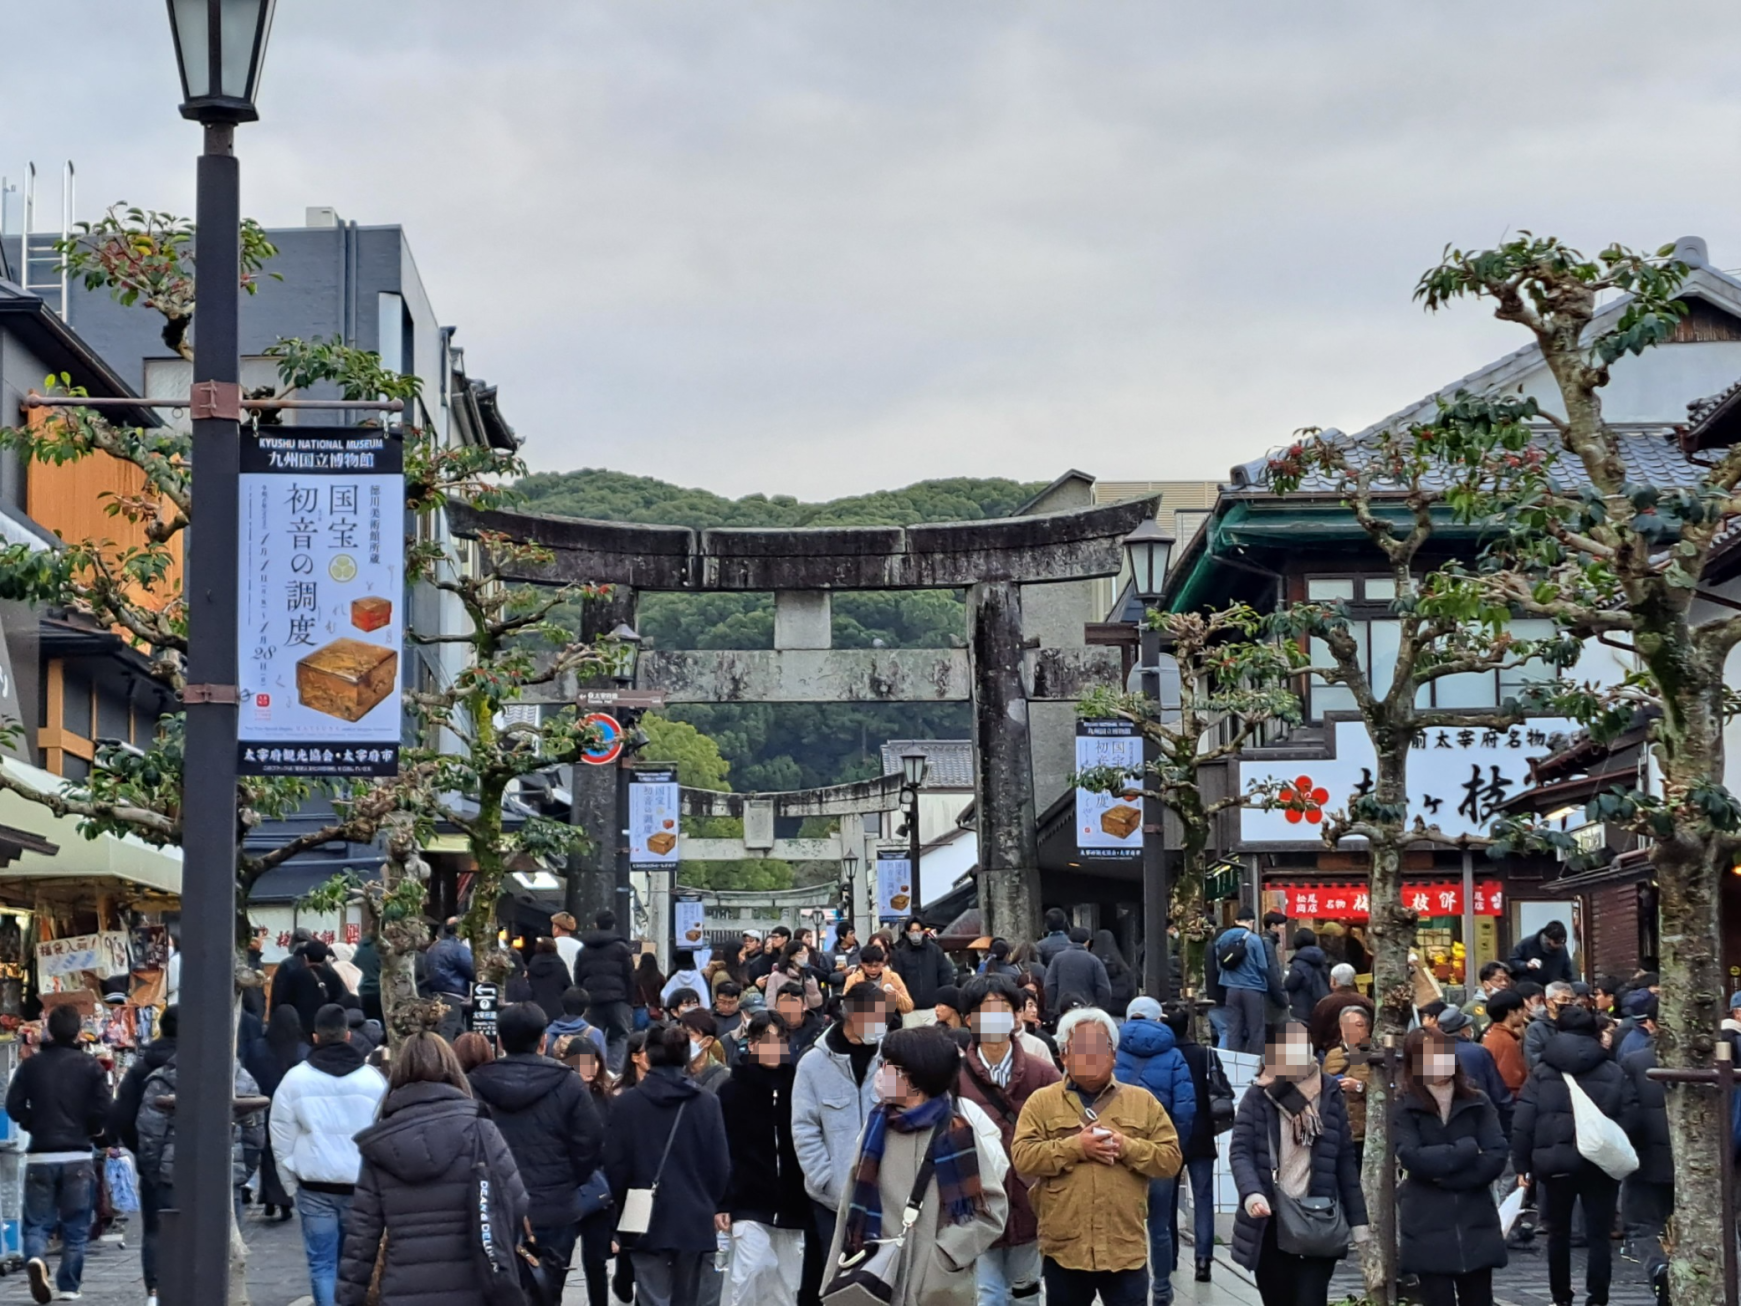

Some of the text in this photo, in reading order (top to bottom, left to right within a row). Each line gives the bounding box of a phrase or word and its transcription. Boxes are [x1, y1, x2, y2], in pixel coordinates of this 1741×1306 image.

[259, 438, 384, 450] KYUSHU NATIONAL MUSEUM
[268, 451, 375, 469] 九州国立博物館
[328, 484, 359, 550] 国宝
[284, 482, 319, 648] 初音の調度
